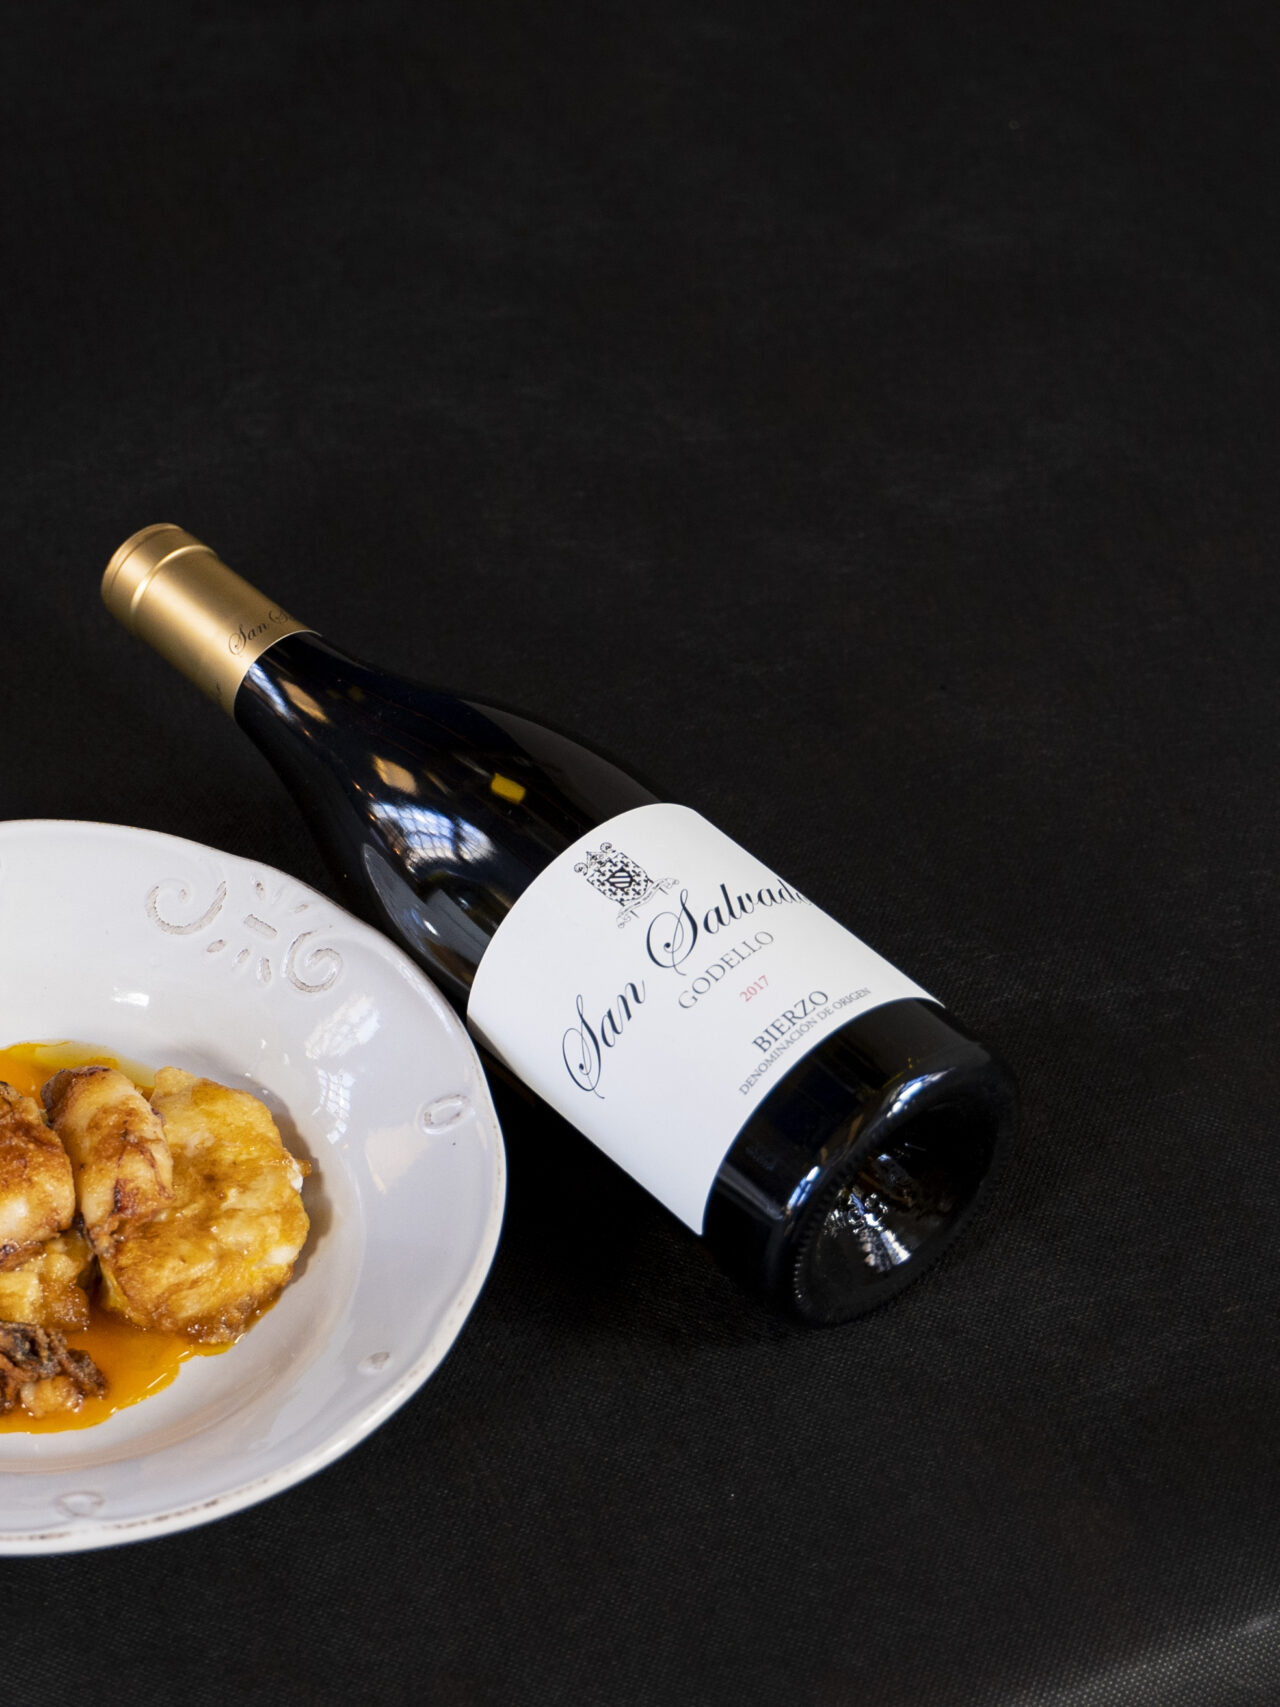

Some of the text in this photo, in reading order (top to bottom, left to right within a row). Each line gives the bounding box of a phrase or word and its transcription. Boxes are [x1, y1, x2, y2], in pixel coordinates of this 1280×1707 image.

[228, 623, 267, 656] San
[677, 930, 774, 1009] GODELLO
[739, 974, 770, 1003] 2017
[751, 990, 829, 1054] BIERZO
[816, 1007, 834, 1021] DE
[832, 986, 872, 1010] ORIGEN
[562, 979, 646, 1100] San
